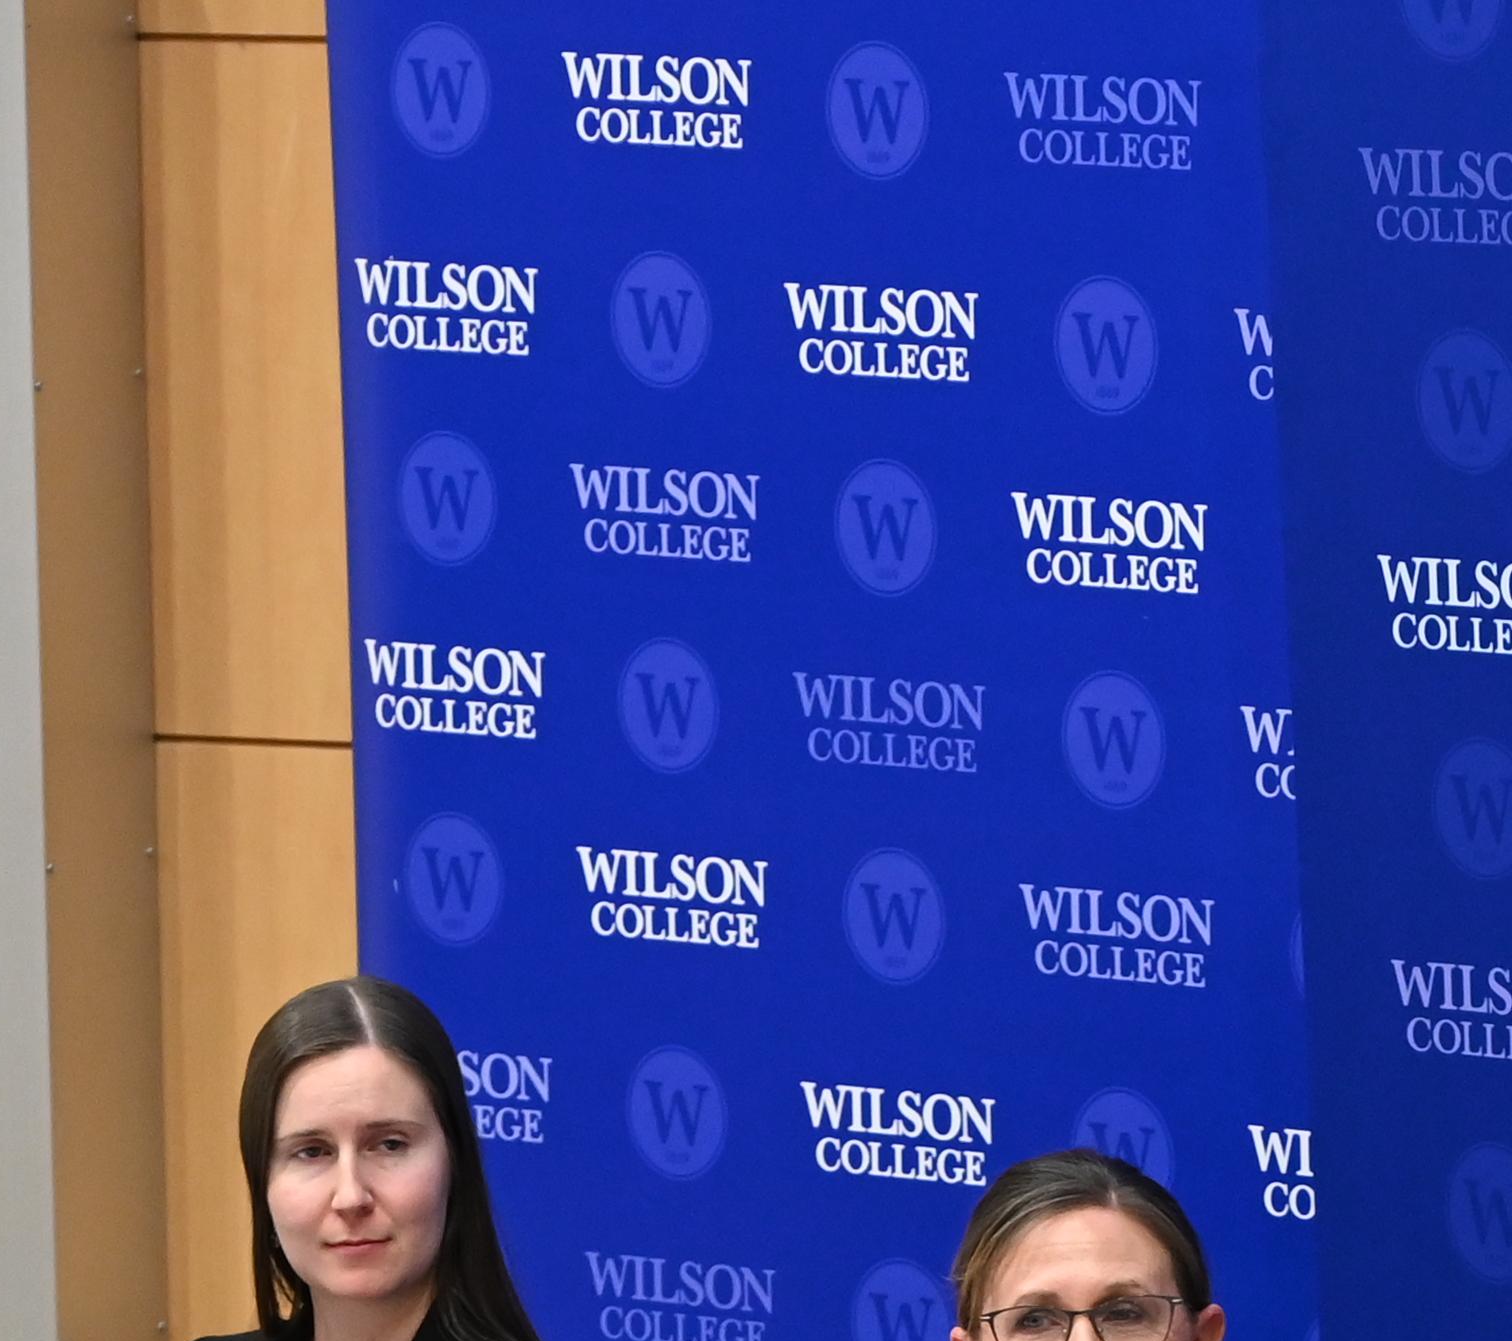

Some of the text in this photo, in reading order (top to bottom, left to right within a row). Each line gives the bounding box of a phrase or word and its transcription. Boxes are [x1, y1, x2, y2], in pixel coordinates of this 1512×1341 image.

[408, 58, 472, 123] W
[561, 52, 752, 106] WILSON
[1004, 73, 1201, 126] WILSON
[576, 107, 743, 149] COLLEGE
[844, 78, 910, 145] W
[1020, 129, 1191, 169] COLLEGE
[356, 256, 538, 314] WILSON
[784, 283, 979, 339] WILSON
[367, 313, 529, 356] COLLEGE
[629, 287, 693, 353] W
[1072, 313, 1140, 378] W
[799, 338, 969, 382] COLLEGE
[570, 464, 760, 520] WILSON
[585, 519, 750, 562] COLLEGE
[853, 496, 918, 562] W
[1011, 492, 1208, 551] WILSON
[1027, 548, 1198, 594] COLLEGE
[366, 640, 546, 698] WILSON
[376, 694, 536, 739] COLLEGE
[636, 674, 700, 738] W
[794, 673, 984, 729] WILSON
[809, 729, 975, 772] COLLEGE
[576, 846, 768, 907] WILSON
[591, 901, 759, 948] COLLEGE
[1019, 884, 1214, 945] WILSON
[1035, 940, 1205, 987] COLLEGE
[800, 1081, 996, 1144] WILSON
[816, 1137, 986, 1186] COLLEGE
[587, 1252, 774, 1311] WILSON
